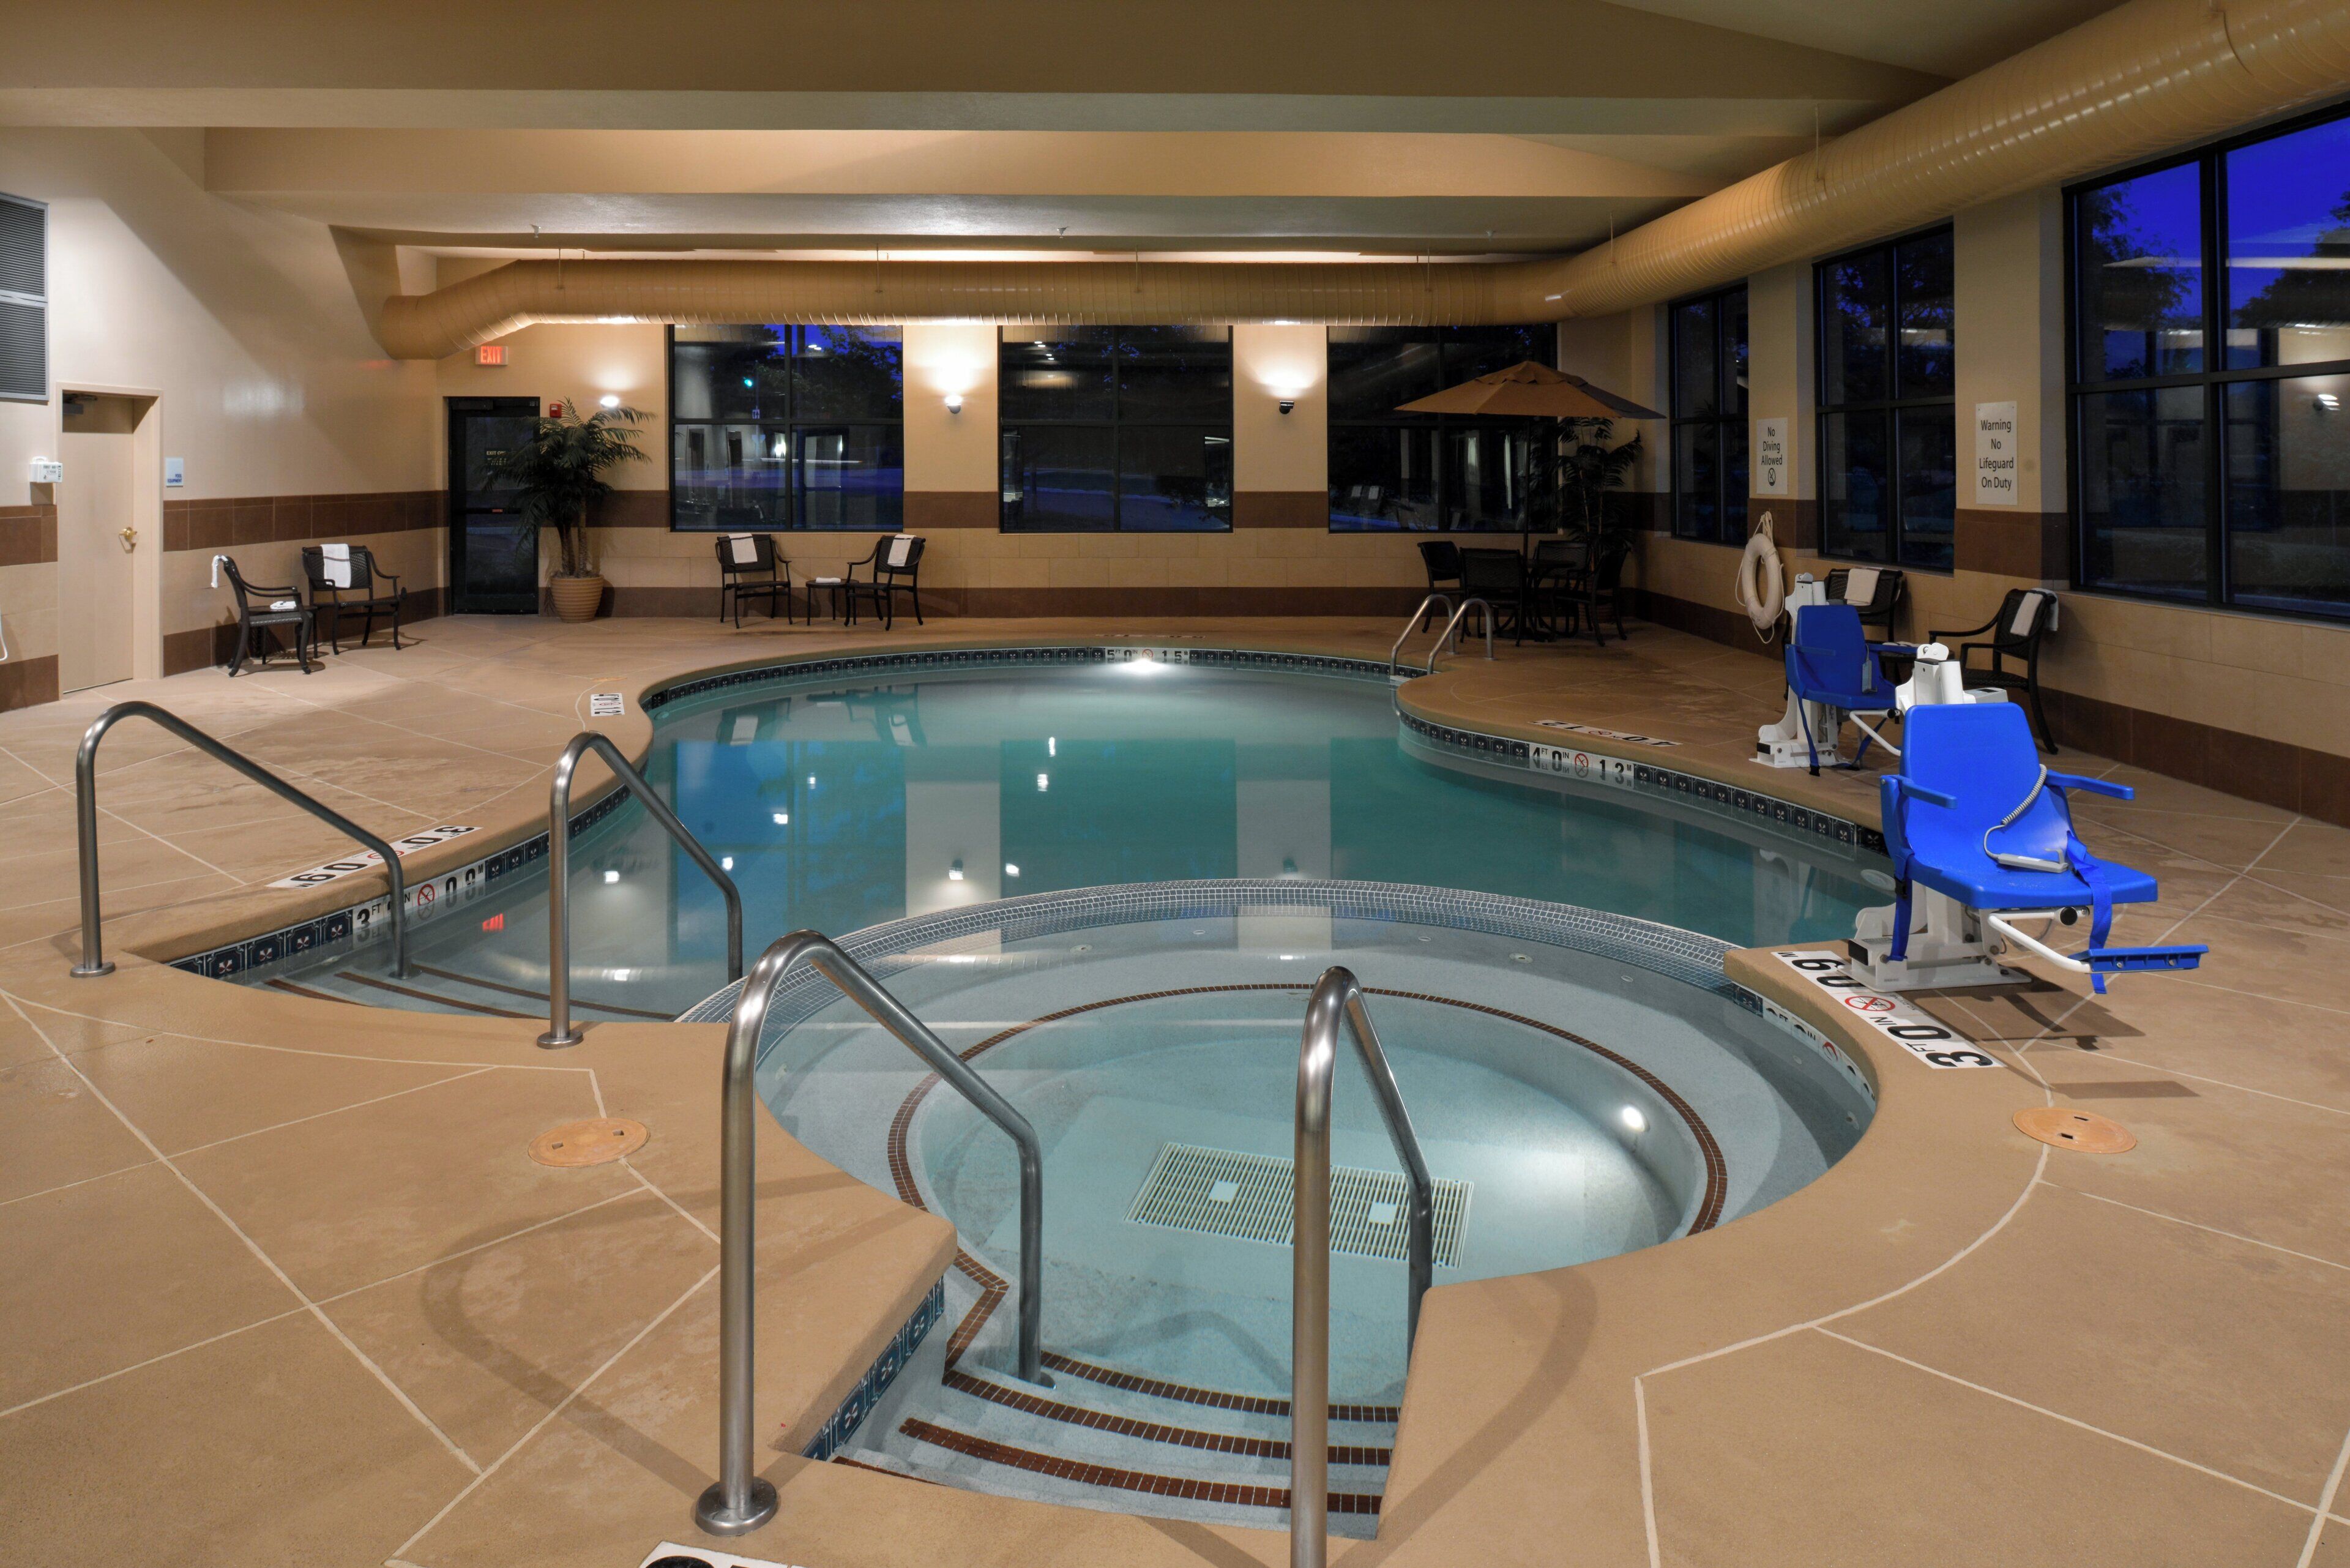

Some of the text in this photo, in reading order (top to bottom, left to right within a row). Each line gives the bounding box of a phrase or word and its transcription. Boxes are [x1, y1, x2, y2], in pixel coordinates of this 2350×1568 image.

[480, 346, 502, 363] EXIT
[1767, 427, 1775, 436] No
[1981, 419, 2012, 433] Warning
[1763, 441, 1780, 454] Diving
[1991, 438, 2001, 449] No
[1761, 455, 1783, 465] Allowed
[1979, 457, 2014, 472] Lifeguard
[1981, 477, 2012, 491] On Duty
